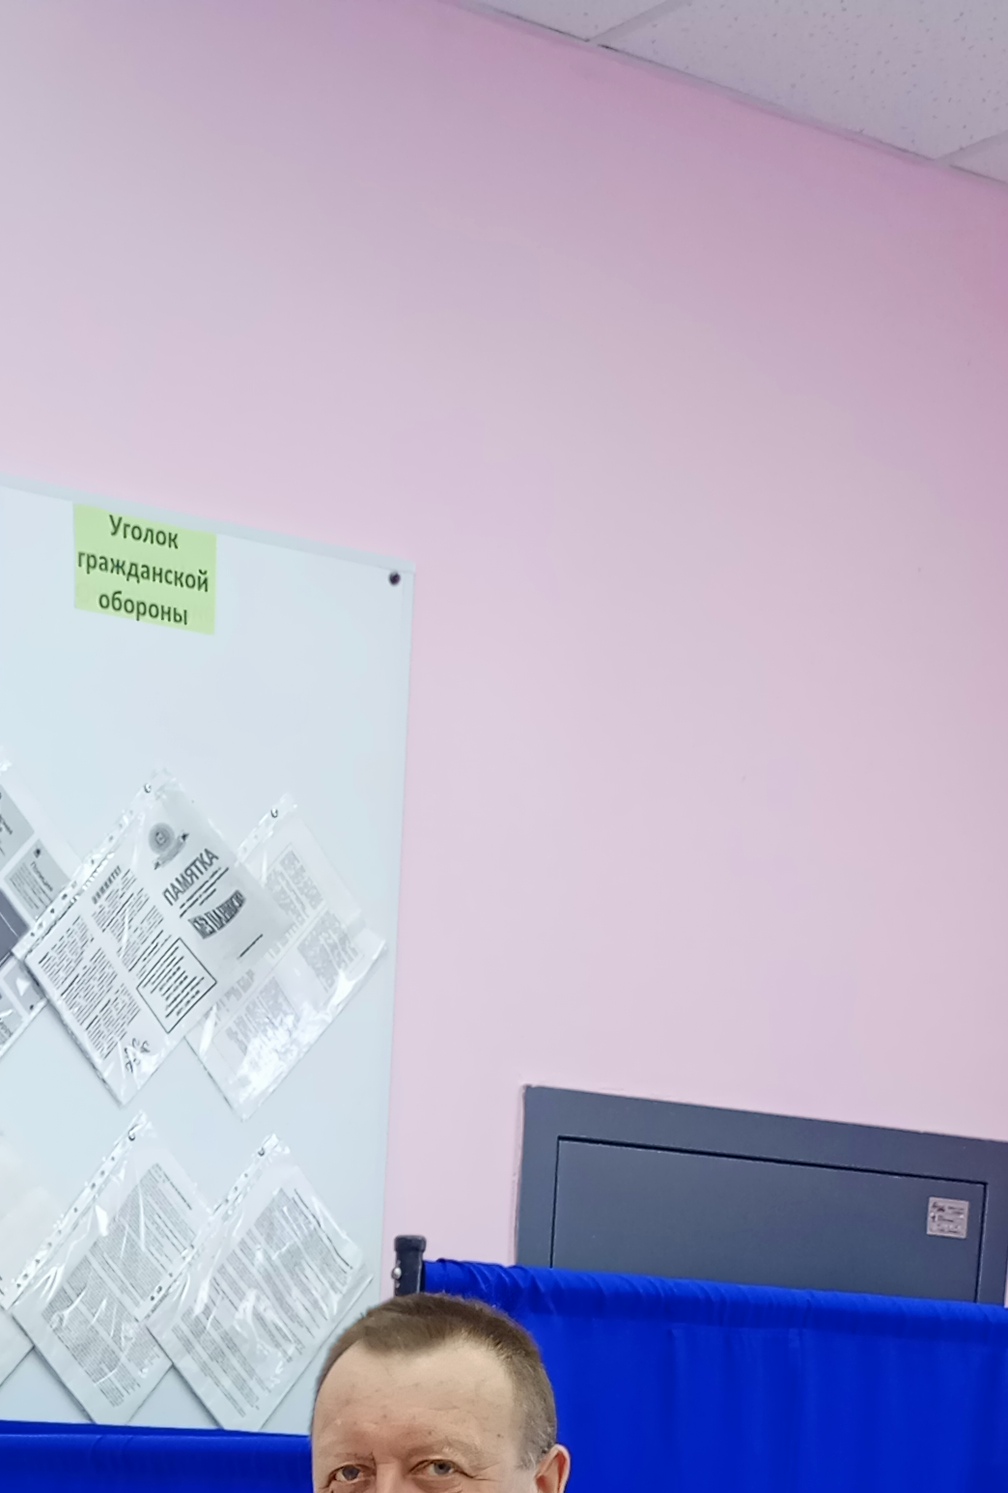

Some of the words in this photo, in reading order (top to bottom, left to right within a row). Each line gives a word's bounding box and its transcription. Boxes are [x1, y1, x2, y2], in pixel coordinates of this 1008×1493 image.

[109, 514, 179, 549] Уголок
[77, 551, 209, 593] гражданской
[98, 590, 188, 625] обороны
[162, 848, 219, 906] ПАМЯТКА
